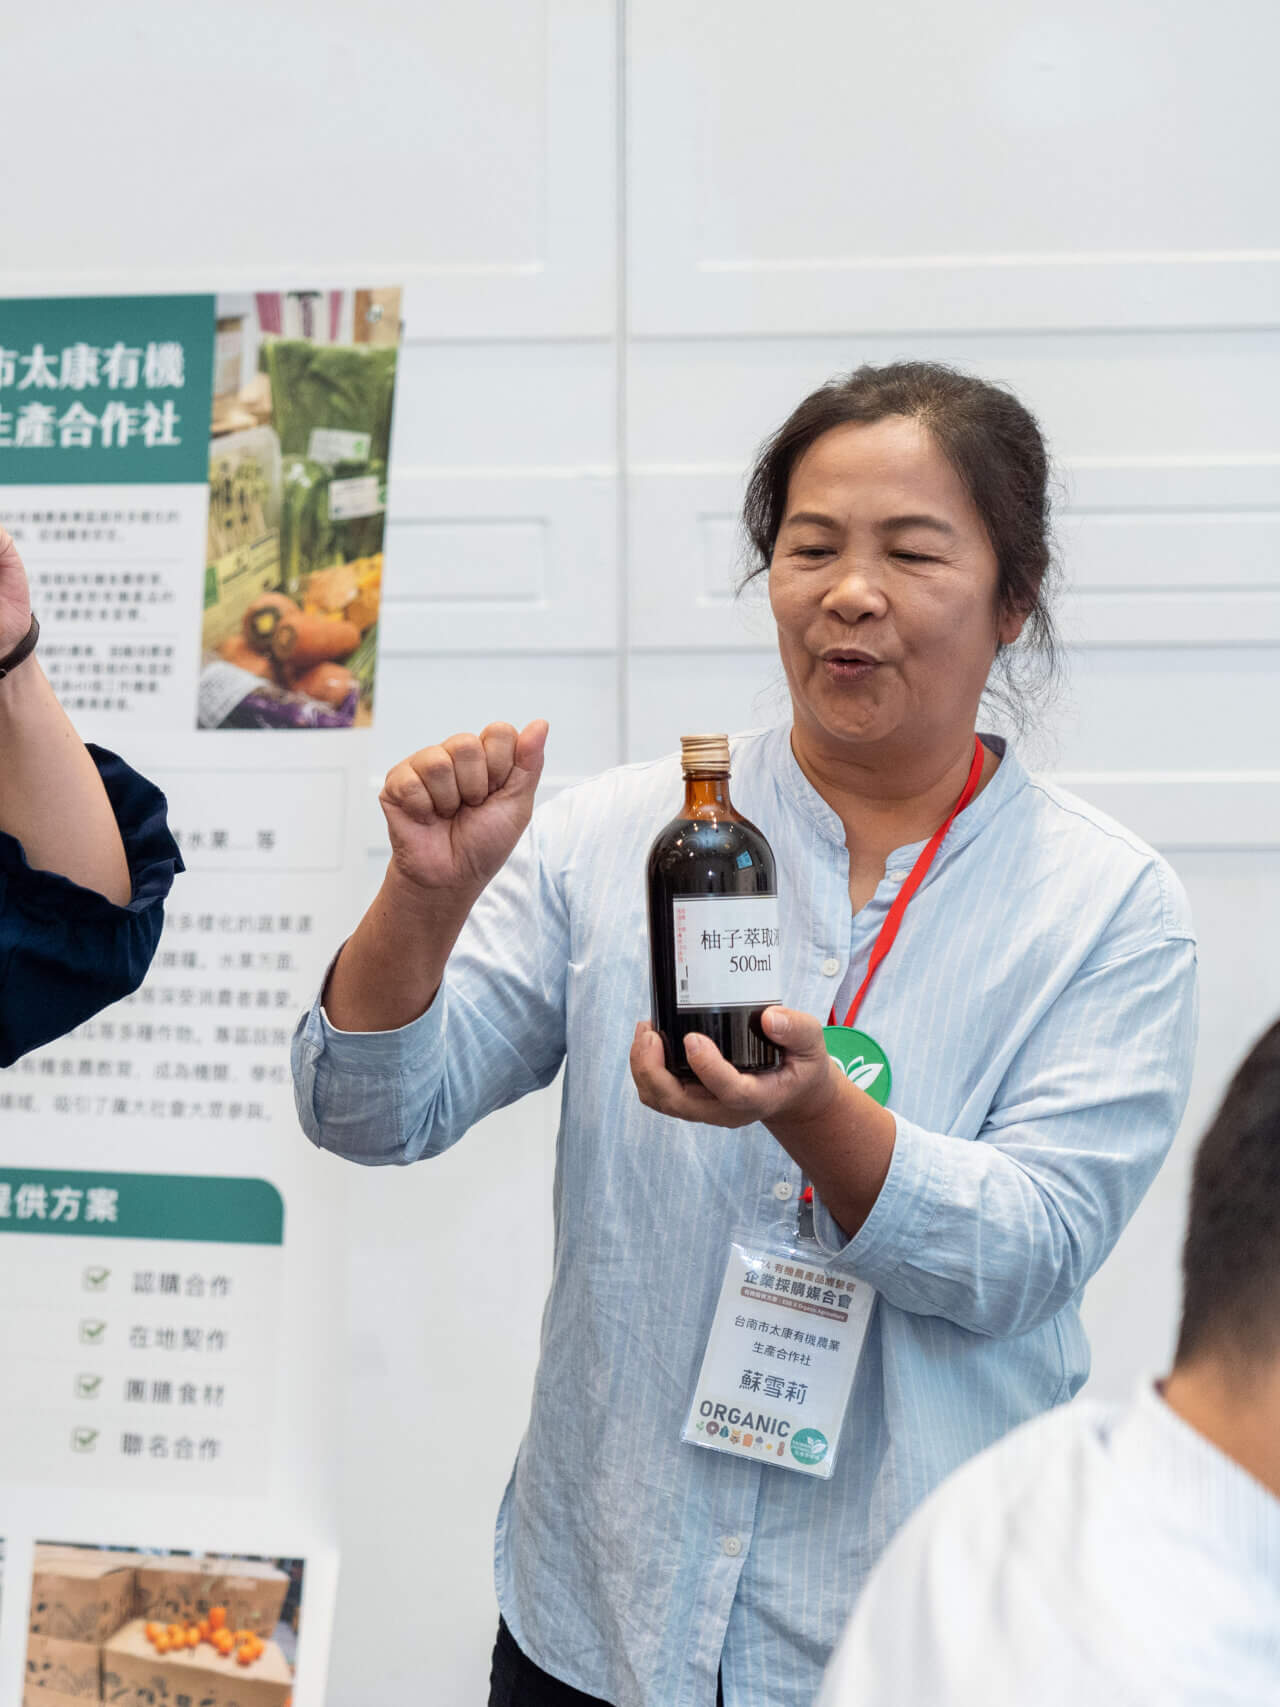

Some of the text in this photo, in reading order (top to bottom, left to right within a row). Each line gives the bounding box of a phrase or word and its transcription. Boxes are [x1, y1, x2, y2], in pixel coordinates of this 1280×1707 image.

[729, 954, 772, 973] 500ml
[744, 1270, 852, 1309] 企業採購媒合會
[128, 1326, 229, 1352] 在地契作
[734, 1315, 841, 1352] 台南市太康有機農業
[752, 1341, 812, 1366] 生產合作社
[739, 1369, 808, 1405] 蘇雪莉
[700, 1400, 791, 1438] ORGANIC
[120, 1433, 222, 1461] 聯名合作
